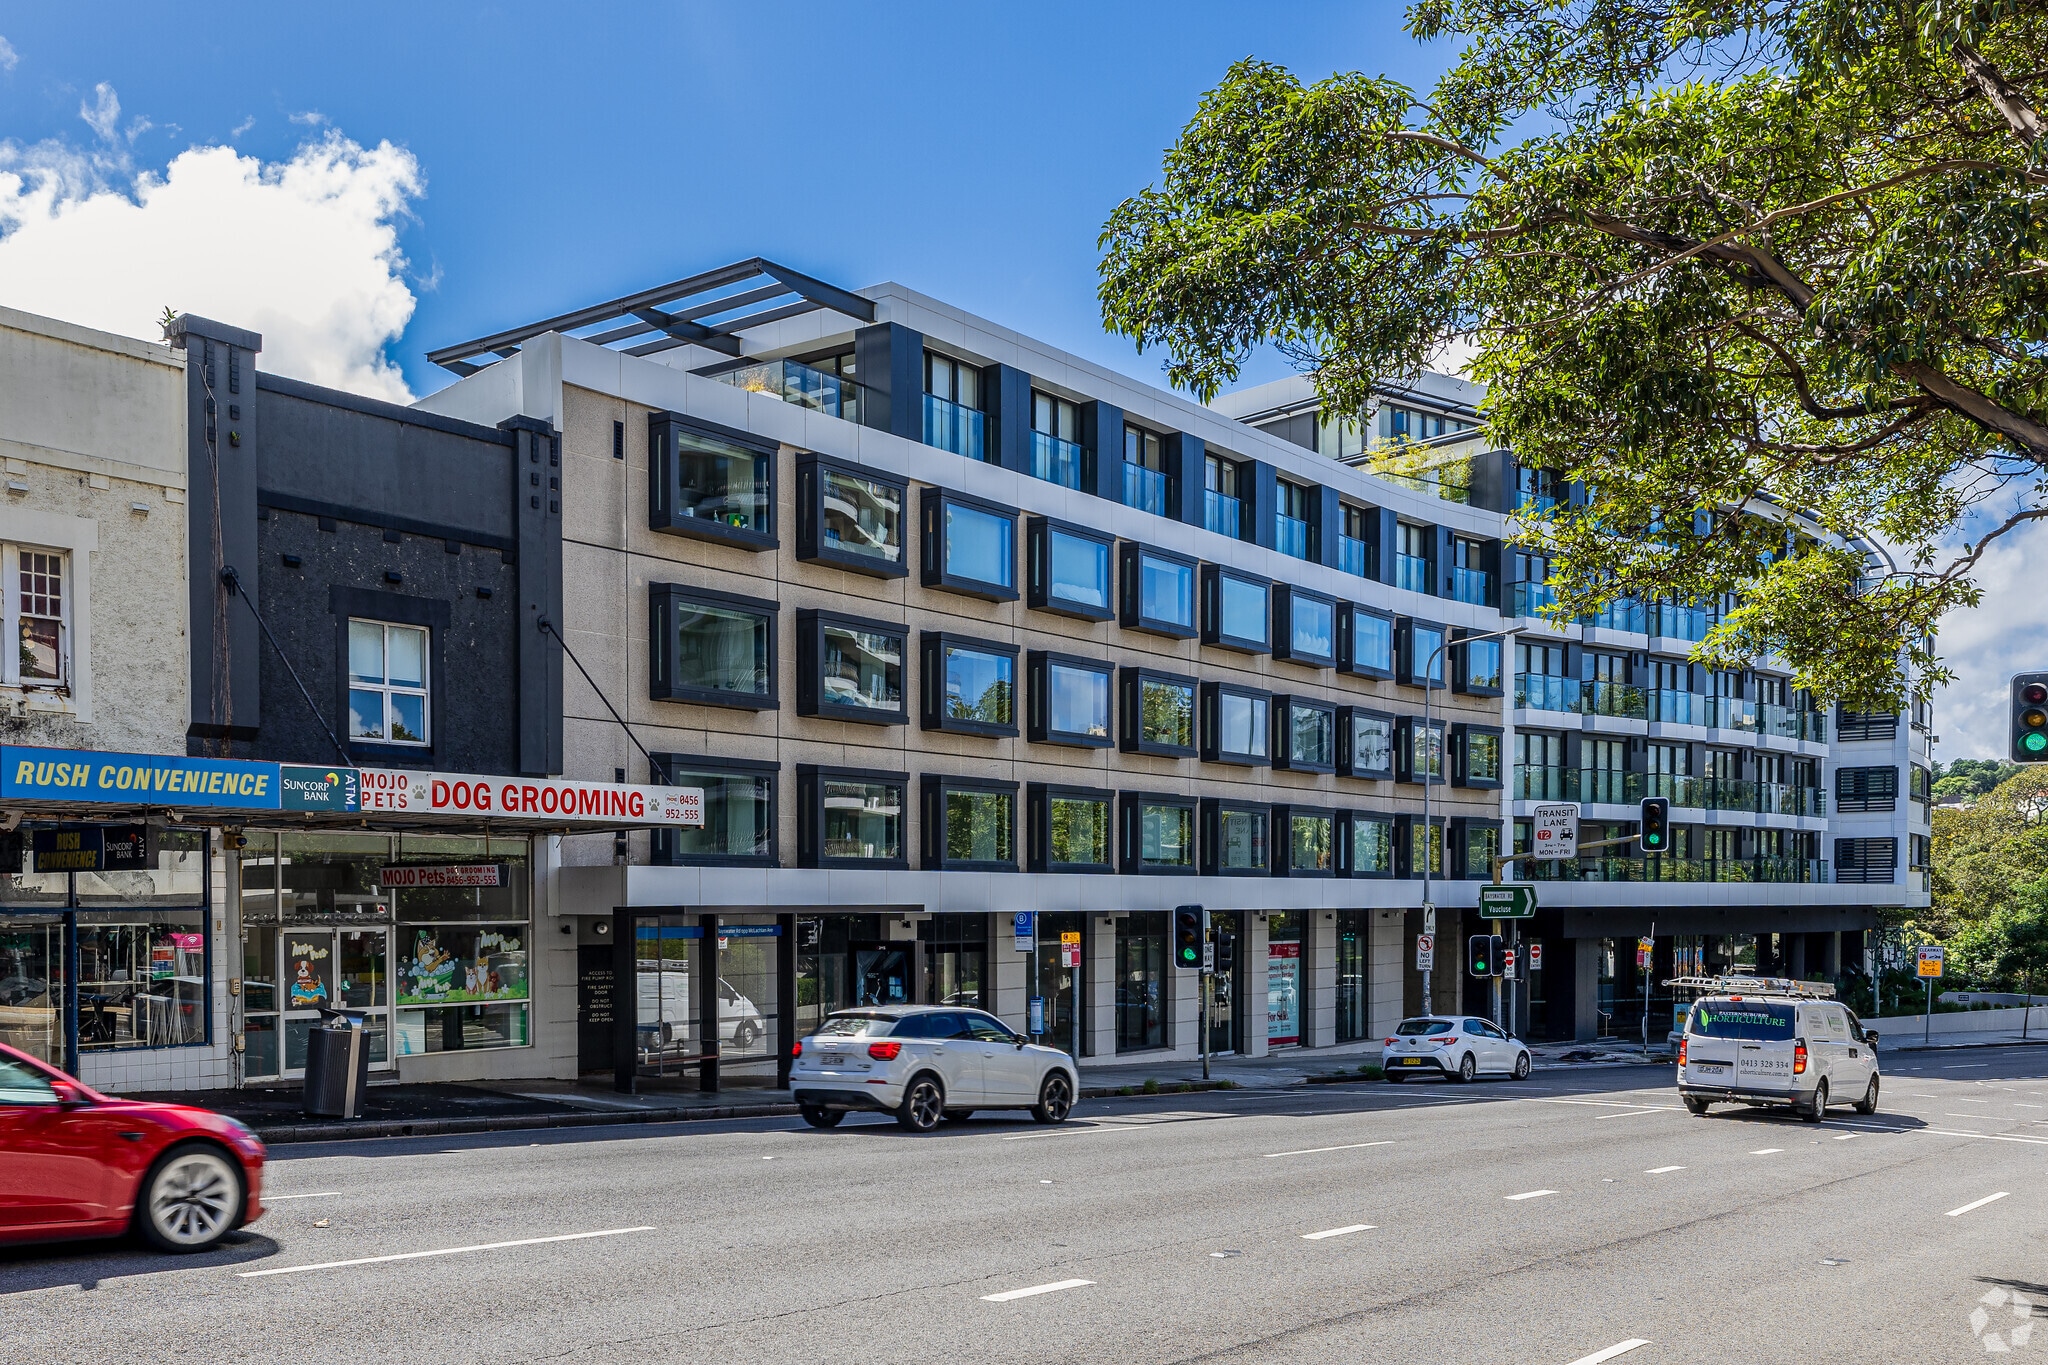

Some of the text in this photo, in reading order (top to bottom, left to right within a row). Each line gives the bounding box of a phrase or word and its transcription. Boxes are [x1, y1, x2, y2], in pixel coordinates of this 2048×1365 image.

[15, 761, 269, 796] RUSH CONVENIENCE
[361, 772, 408, 790] MOJO
[283, 779, 330, 791] SUNCORP
[345, 774, 356, 805] ATM
[304, 792, 329, 801] BANK
[361, 791, 408, 809] PETS
[432, 780, 644, 817] DOG GROOMING
[680, 795, 699, 805] 0456
[665, 809, 699, 819] 952-555
[1537, 809, 1575, 817] TRANSIT
[56, 832, 80, 850] RUSH
[1539, 831, 1550, 839] T2
[106, 842, 133, 852] SUNCORP
[37, 850, 97, 869] CONVENIENCE
[116, 851, 133, 859] BANK
[382, 868, 445, 885] MOJO Pets
[446, 875, 497, 885] 0456-952-555
[1709, 1014, 1786, 1027] HORTICULTURE
[1740, 1059, 1758, 1067] 0413
[1760, 1060, 1774, 1068] 328
